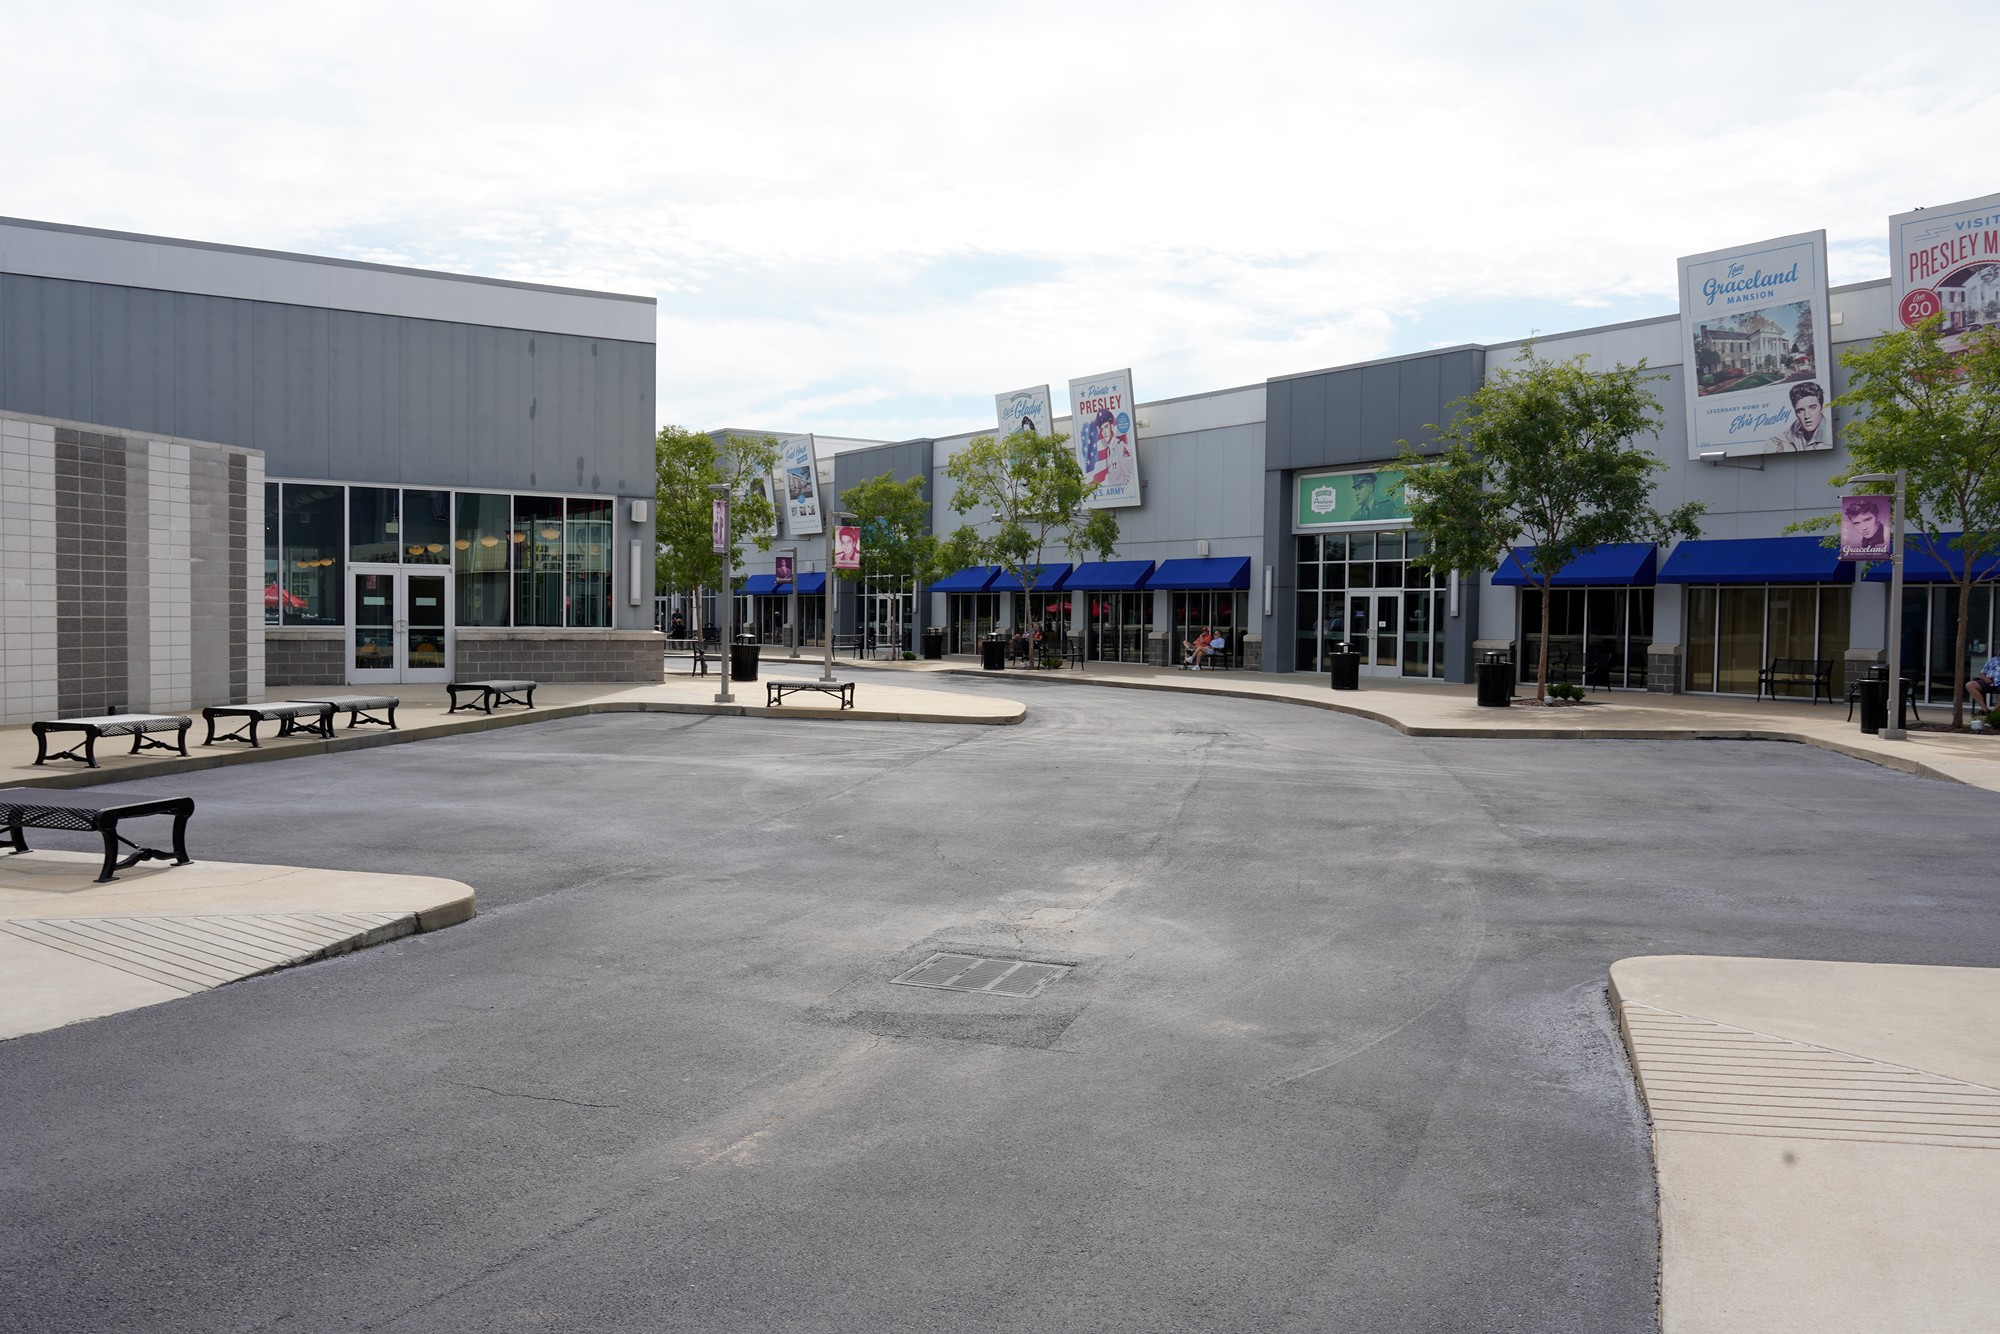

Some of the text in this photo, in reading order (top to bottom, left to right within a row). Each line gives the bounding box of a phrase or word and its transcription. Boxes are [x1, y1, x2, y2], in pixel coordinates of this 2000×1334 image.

[1955, 214, 2000, 231] VISIT
[1909, 232, 1979, 283] PRESLEY
[1727, 262, 1745, 278] Tour
[1703, 262, 1799, 306] Graceland
[1727, 290, 1774, 304] MANSION
[1908, 301, 1932, 318] 20
[1079, 395, 1122, 415] PRESLEY
[1706, 406, 1740, 414] LEGENDARY
[1729, 406, 1793, 434] Elvis Presley
[1106, 487, 1125, 496] ARMY
[1842, 545, 1887, 556] Graceland
